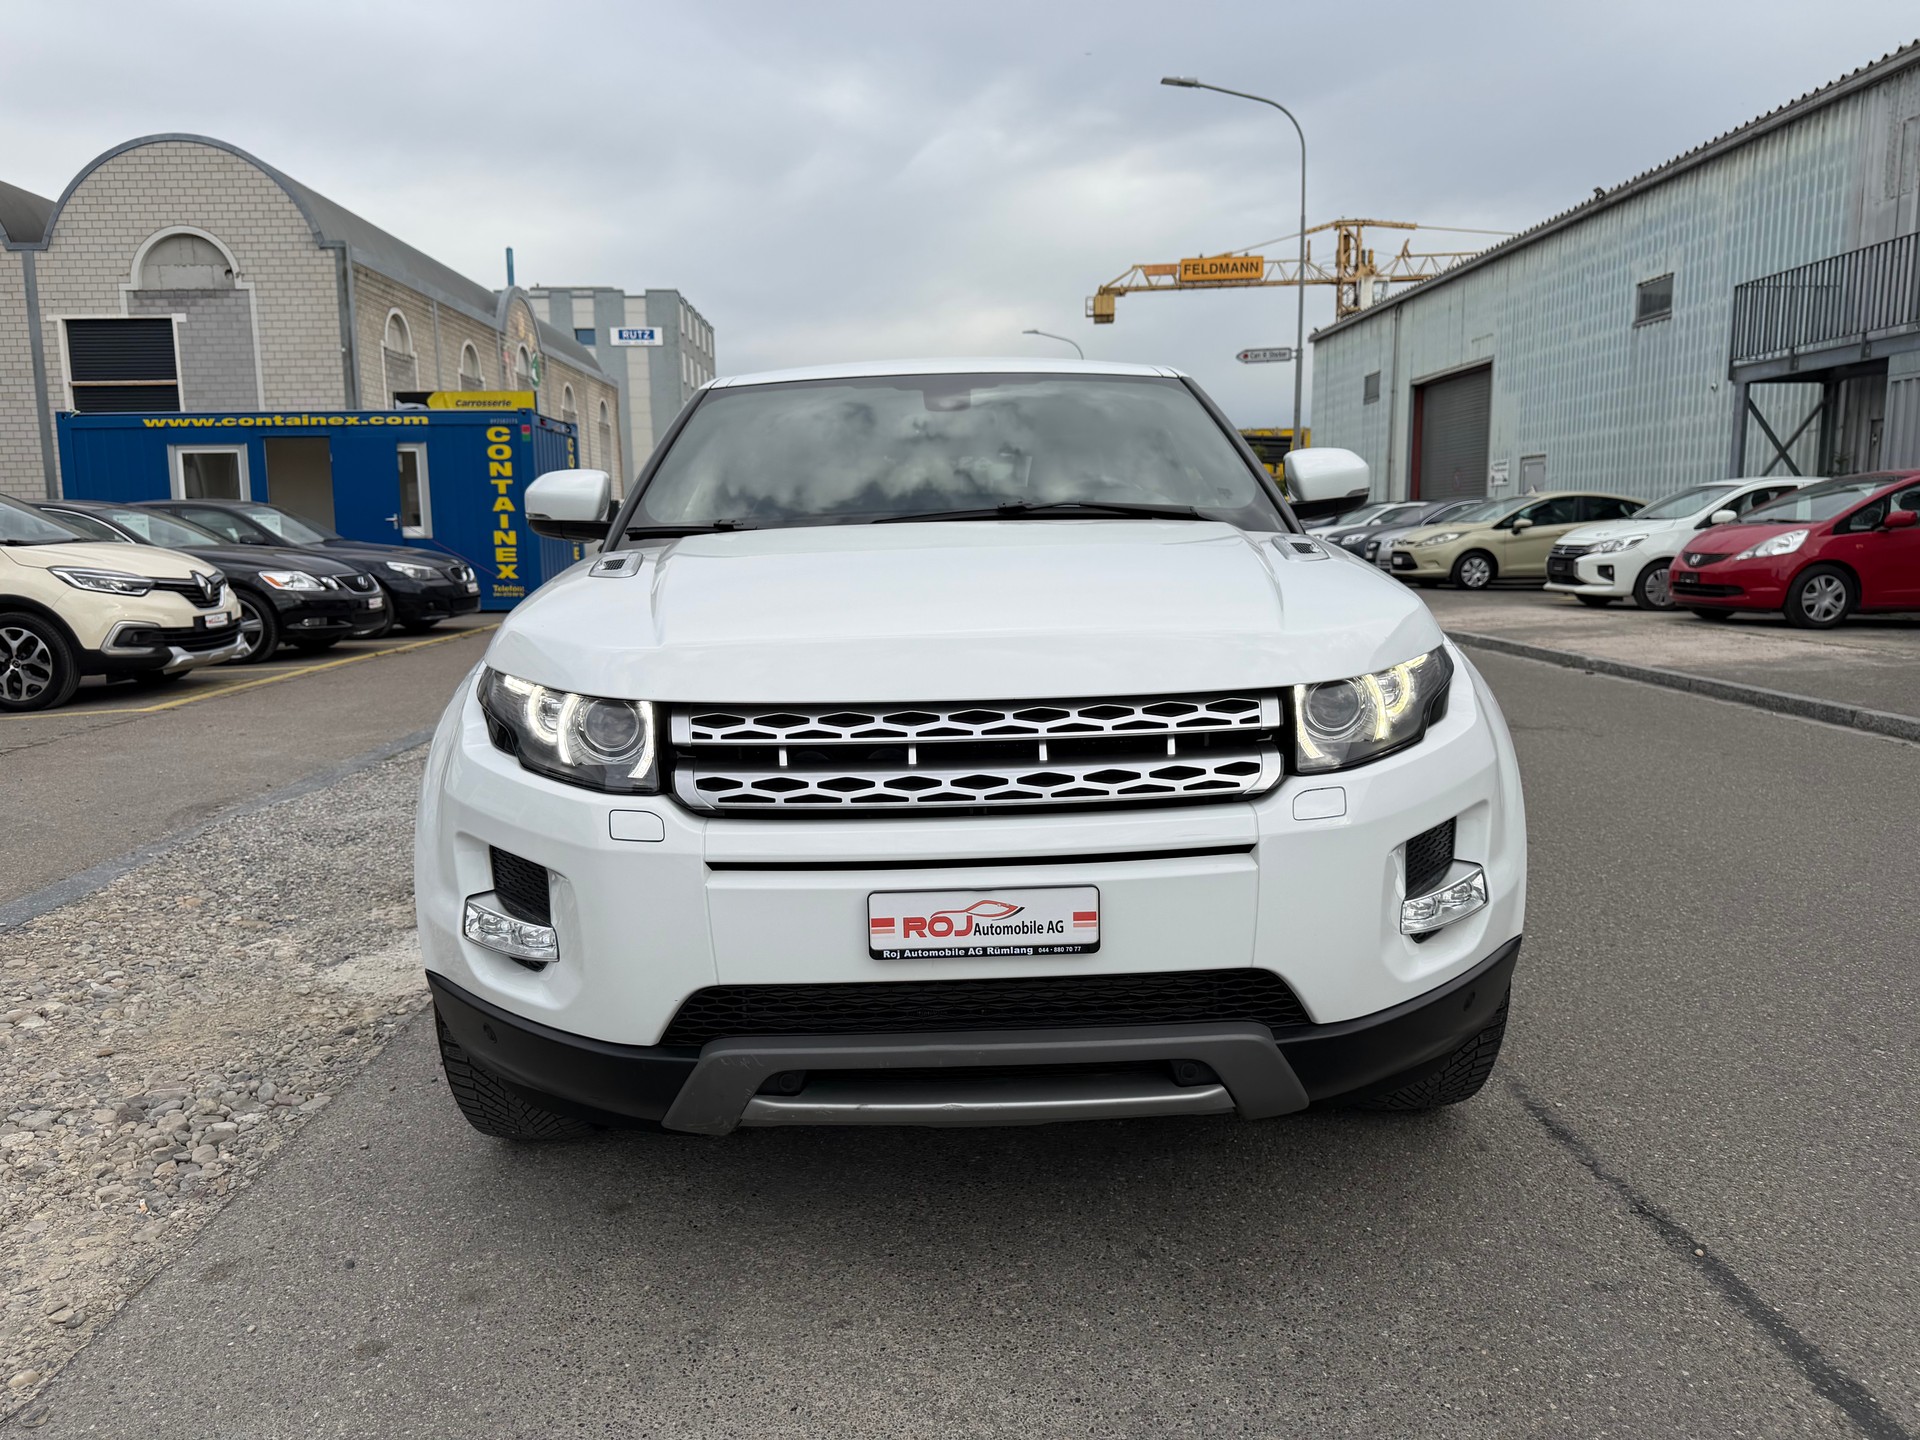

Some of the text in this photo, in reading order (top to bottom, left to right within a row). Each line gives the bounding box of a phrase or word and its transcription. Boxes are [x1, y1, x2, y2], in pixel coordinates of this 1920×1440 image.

[1184, 262, 1259, 275] FELDMANN
[622, 330, 650, 339] RUTZ
[455, 399, 512, 407] Carrosserie
[142, 414, 429, 428] www.containex.com
[486, 426, 519, 579] CONTAINEX
[903, 914, 1064, 938] ROJ Automobile AG
[883, 949, 901, 960] Roj
[904, 947, 965, 957] Automobile
[968, 947, 983, 956] AG
[987, 945, 1034, 957] Rümlang
